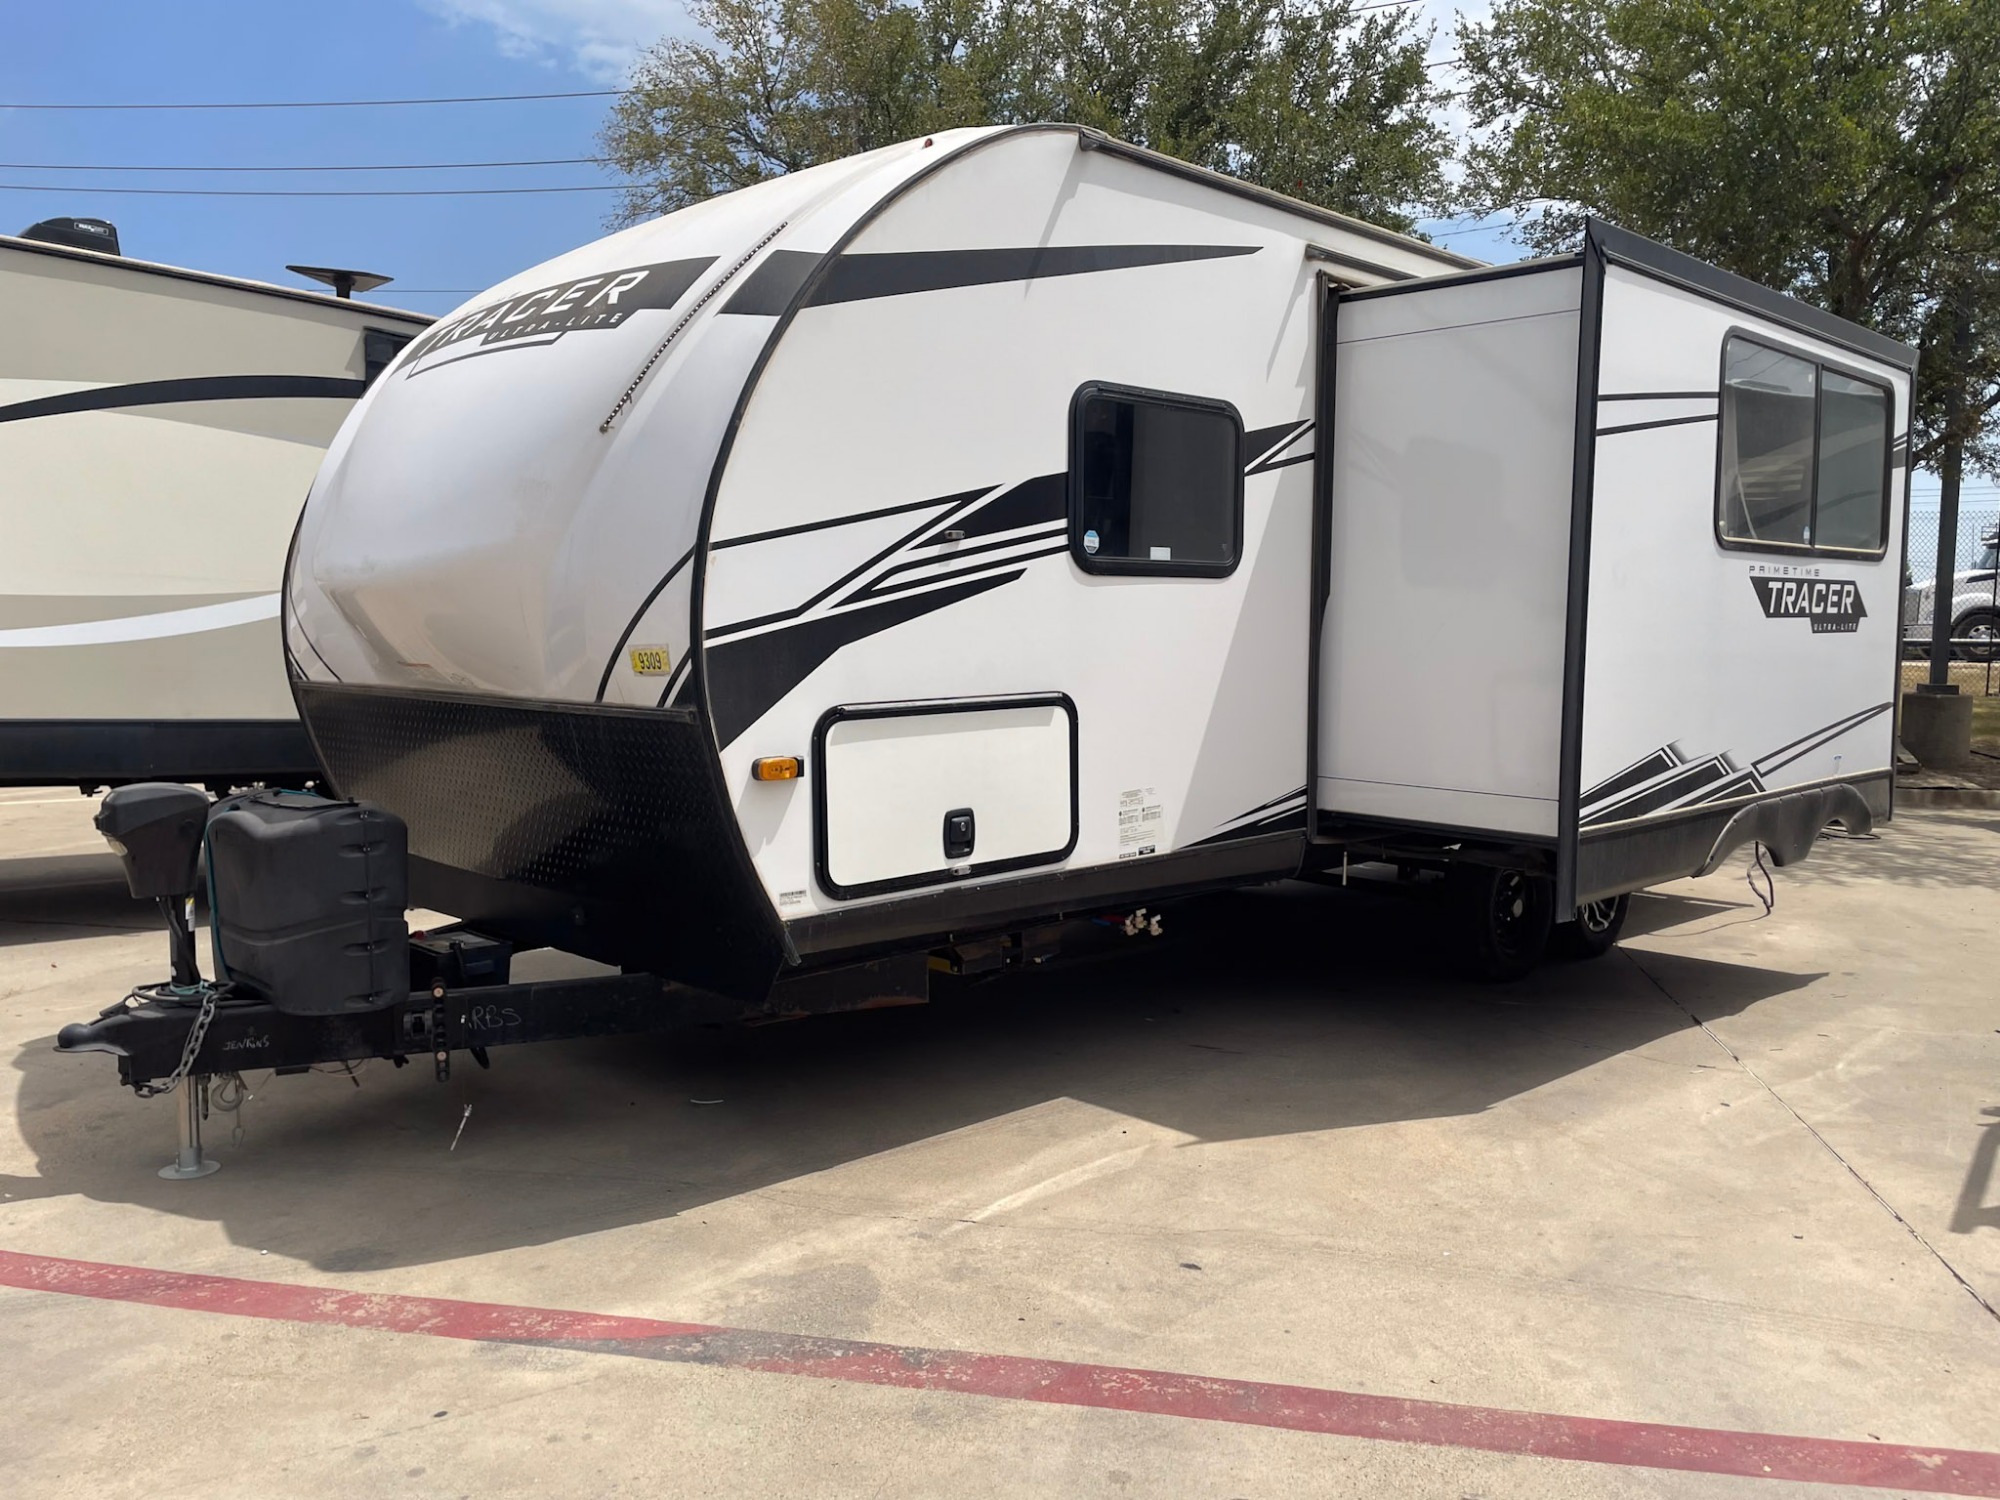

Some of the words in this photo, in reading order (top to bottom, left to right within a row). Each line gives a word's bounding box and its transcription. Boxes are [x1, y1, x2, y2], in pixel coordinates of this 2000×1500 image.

[418, 270, 650, 357] TRACER
[488, 312, 623, 341] ULTRA-LITE
[1749, 565, 1820, 577] PRIMETIME
[1768, 581, 1855, 614] TRACER
[1814, 623, 1857, 631] ULTRA-LITE
[638, 652, 662, 670] 9309
